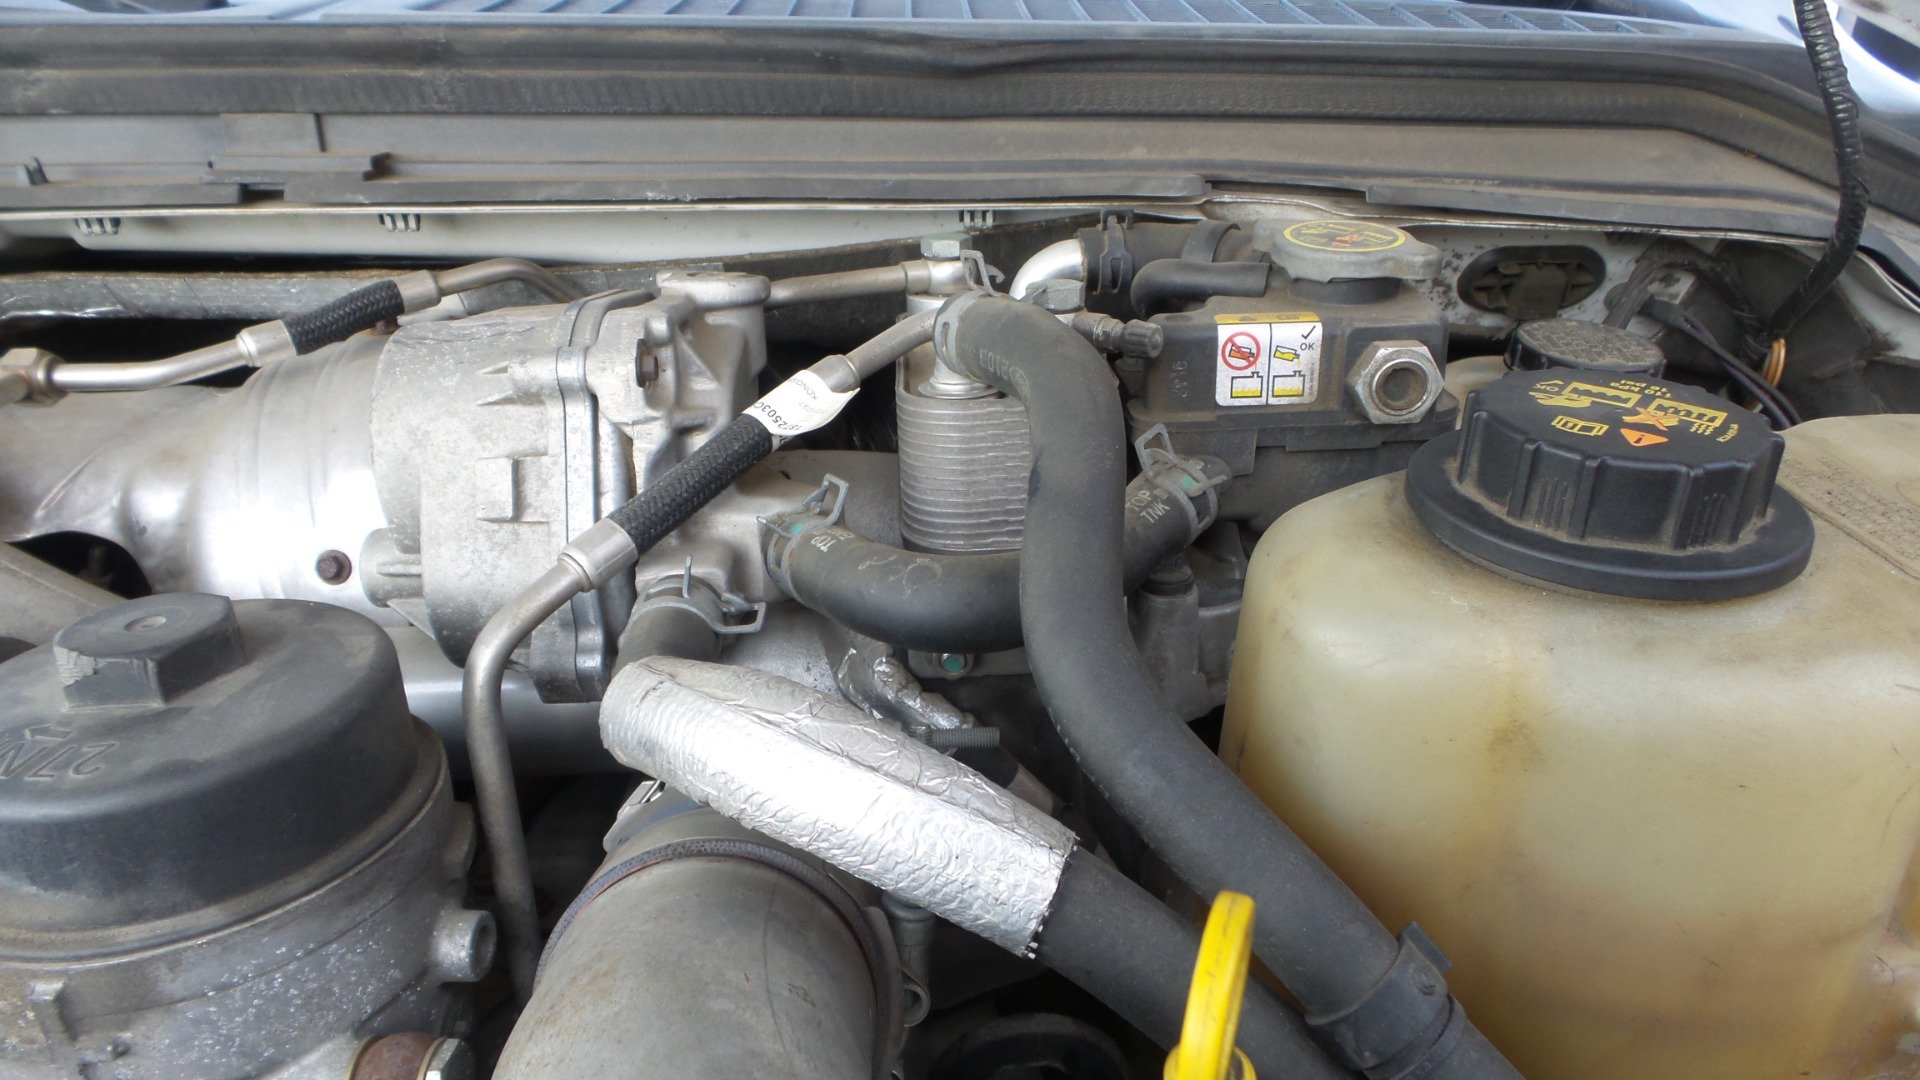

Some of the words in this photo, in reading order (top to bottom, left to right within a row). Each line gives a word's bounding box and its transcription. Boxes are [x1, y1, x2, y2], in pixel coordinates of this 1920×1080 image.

[1299, 342, 1315, 351] OK
[1534, 383, 1559, 392] OK
[1644, 389, 1672, 399] 110
